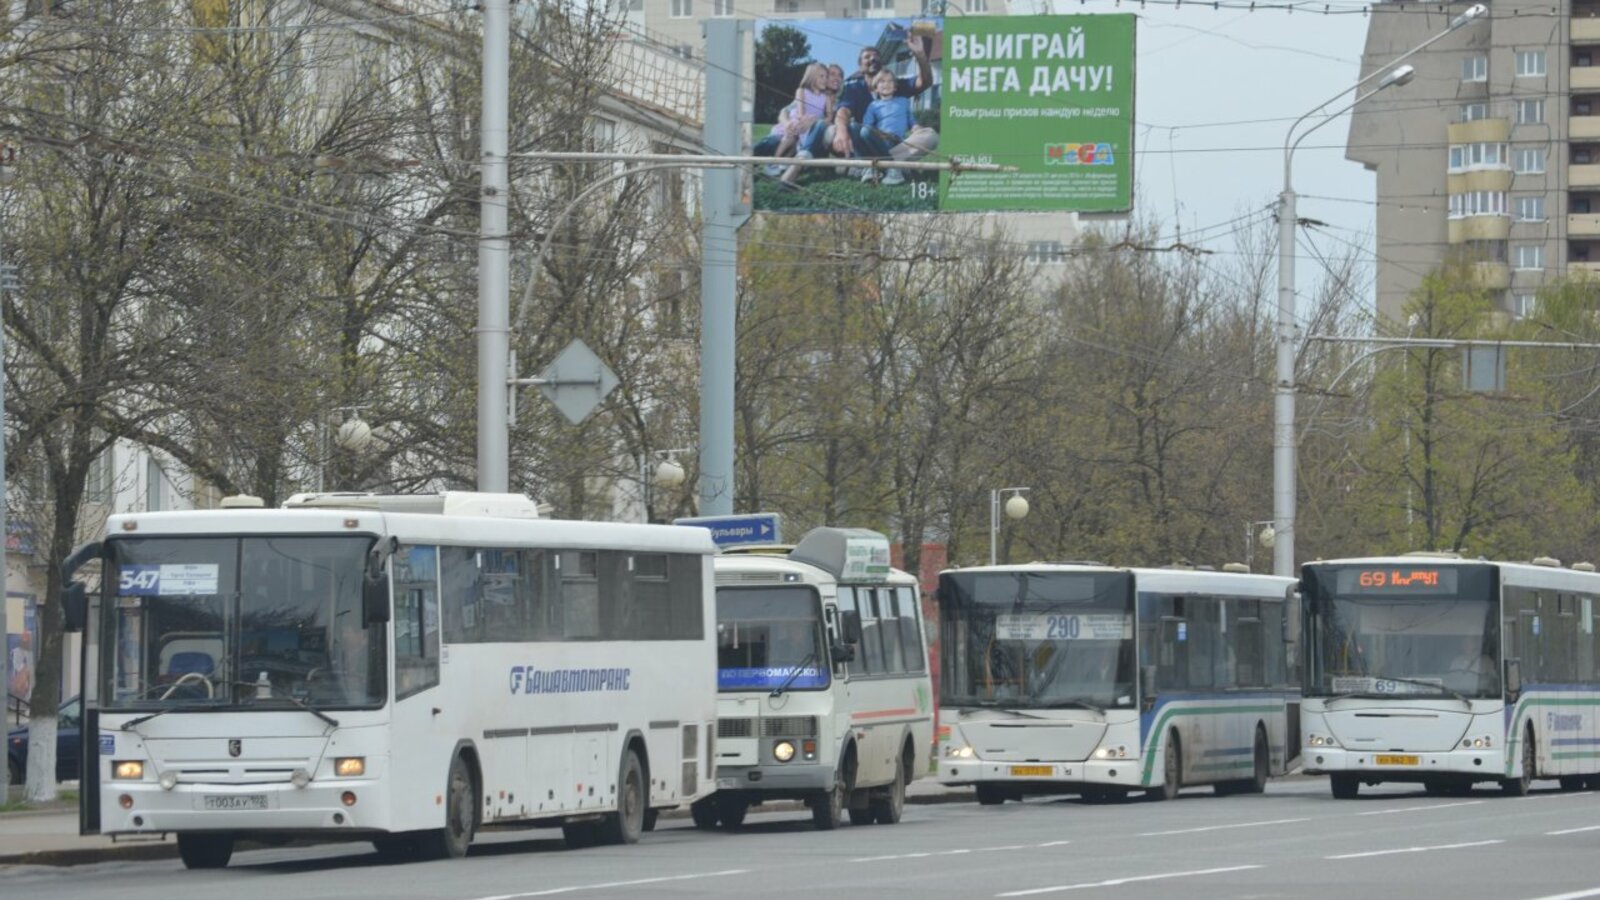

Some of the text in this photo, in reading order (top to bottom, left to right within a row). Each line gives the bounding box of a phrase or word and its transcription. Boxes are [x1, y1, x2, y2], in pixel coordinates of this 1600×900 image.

[951, 26, 1085, 60] ВЫИГРАЙ
[950, 65, 1113, 97] МЕГА ДАЧУ!
[949, 106, 1120, 119] Розыгрыш призов каждую неделю
[910, 180, 937, 199] 18+
[119, 570, 160, 589] 547
[1360, 571, 1386, 586] 69
[1047, 615, 1080, 639] 290
[1376, 680, 1397, 693] 69
